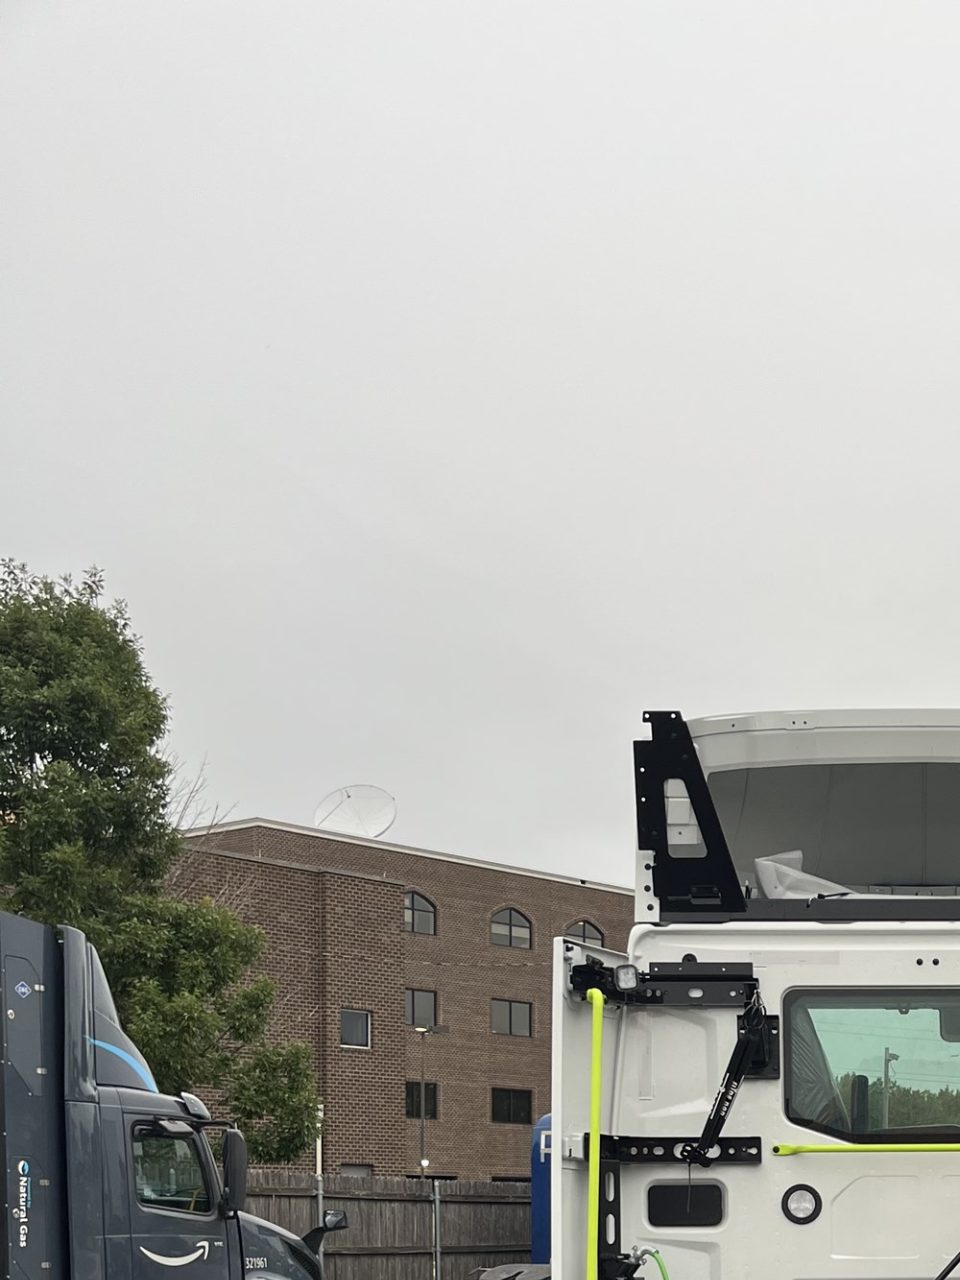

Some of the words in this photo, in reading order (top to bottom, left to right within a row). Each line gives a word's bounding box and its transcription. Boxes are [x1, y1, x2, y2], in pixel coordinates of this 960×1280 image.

[20, 1176, 28, 1222] Natural
[20, 1225, 28, 1247] Gas
[245, 1257, 268, 1269] 321961
